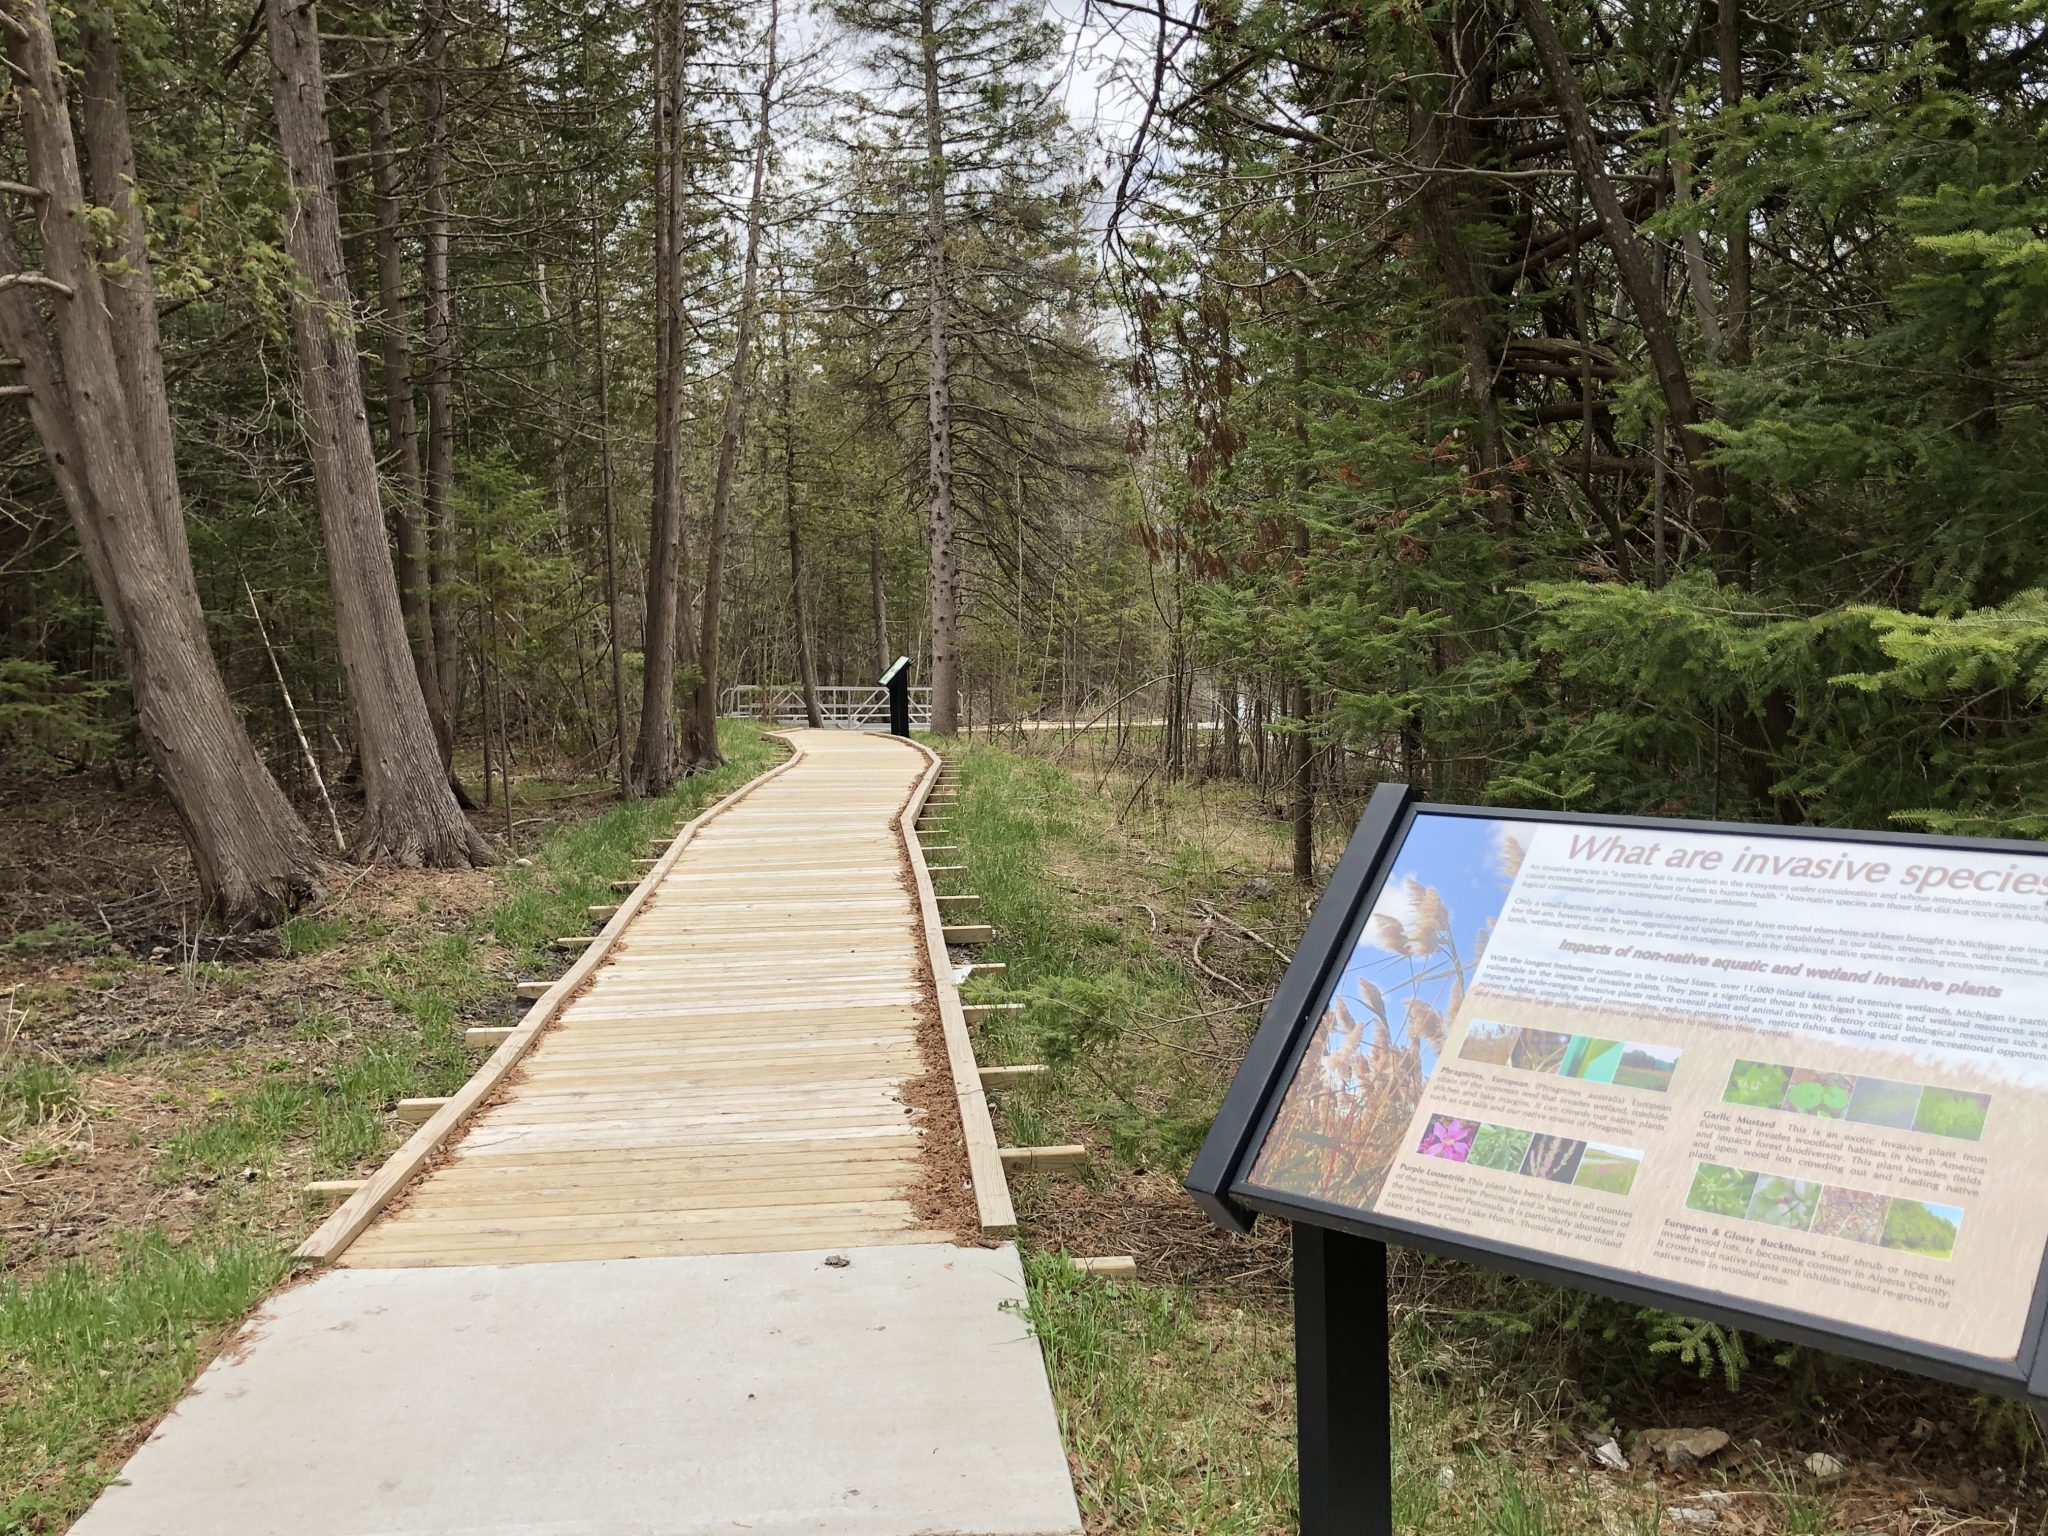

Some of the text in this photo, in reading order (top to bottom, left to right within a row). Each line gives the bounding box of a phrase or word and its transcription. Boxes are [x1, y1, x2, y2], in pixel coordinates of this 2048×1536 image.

[1568, 834, 2048, 896] What are invasive species
[1559, 939, 2002, 997] Impacts of non-native aquatic and wetland invasive plants
[1698, 1119, 1986, 1174] Europe that invades woodland habitats in North America
[1702, 1110, 1988, 1163] Garlic Mustard This is an exotic invasive plant from
[1691, 1141, 1980, 1196] and open wood lots crowding out and shading native
[1663, 1218, 1957, 1285] European & Glossy Buckthorns Small shrub or trees that
